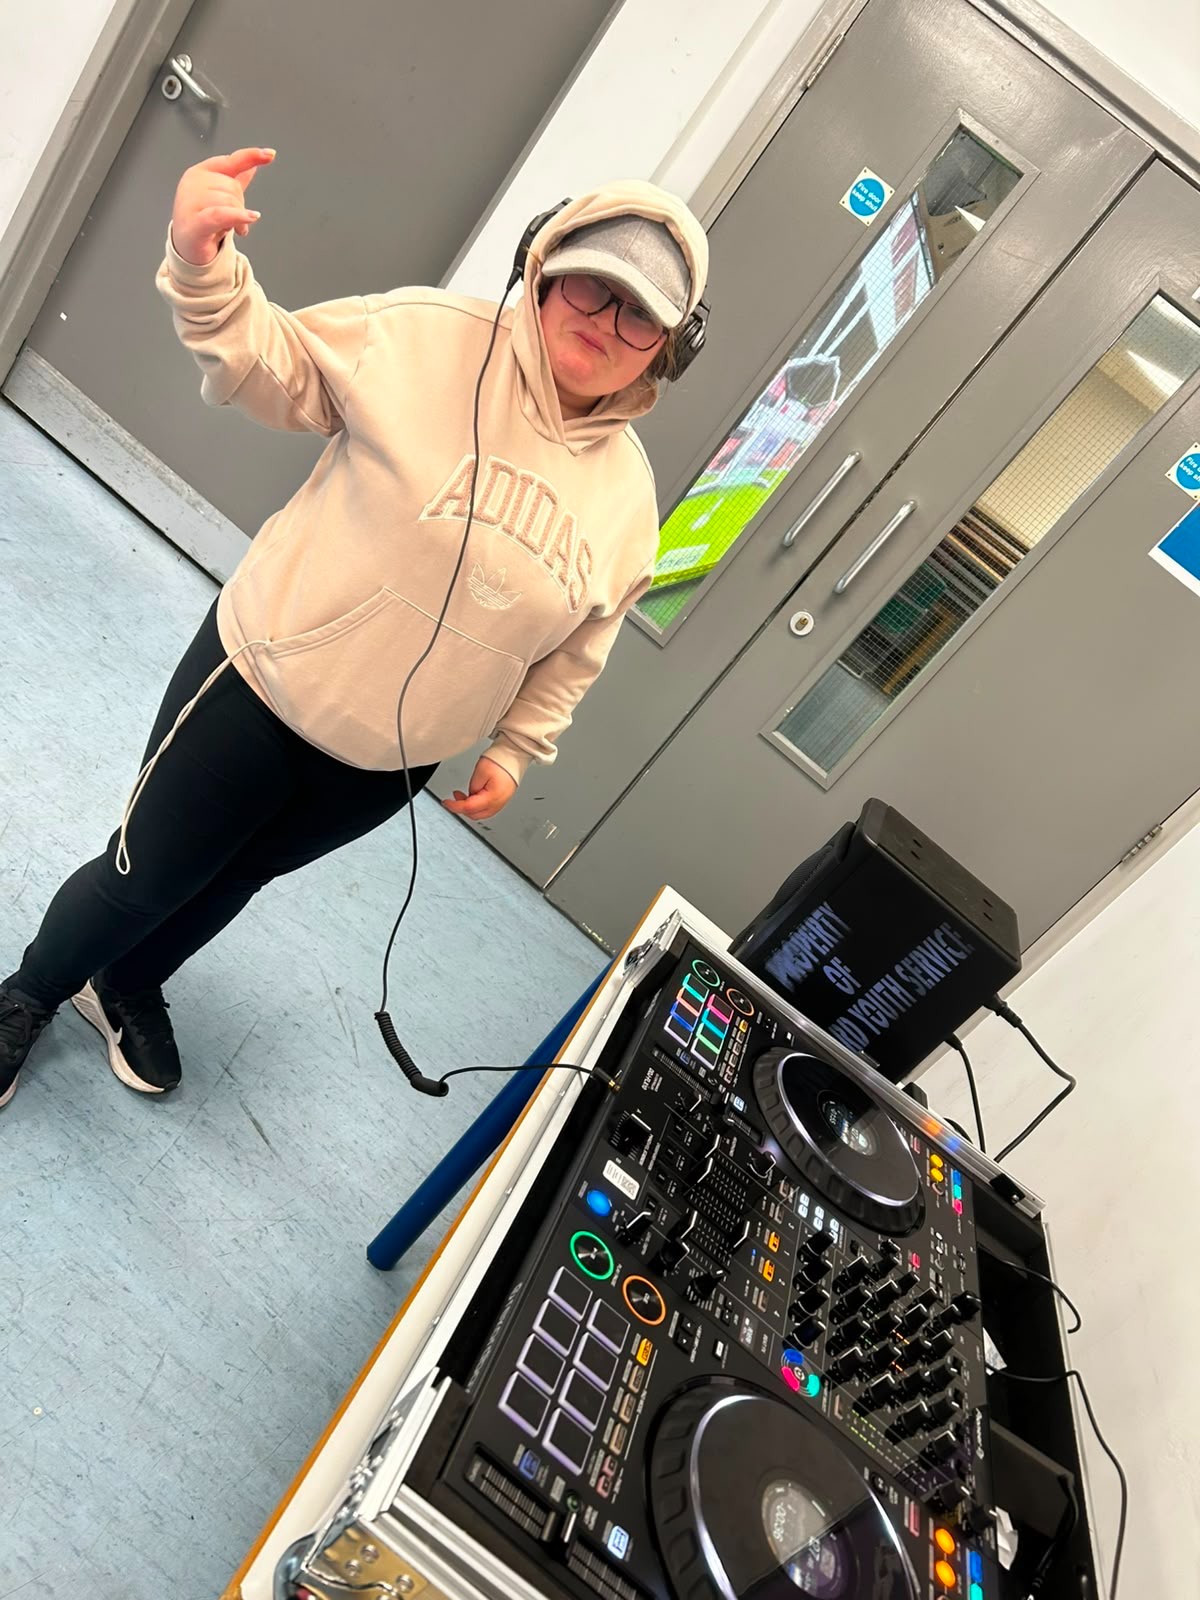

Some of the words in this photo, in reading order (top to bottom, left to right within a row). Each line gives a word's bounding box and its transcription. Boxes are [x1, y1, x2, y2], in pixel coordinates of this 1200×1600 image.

[852, 188, 866, 202] keep
[865, 199, 878, 211] shut
[857, 182, 869, 195] Fire
[868, 192, 881, 204] door
[1180, 461, 1194, 476] keep
[1186, 456, 1198, 469] Fire
[419, 455, 592, 612] ADIDAS
[765, 901, 850, 992] PROPERTY
[822, 956, 861, 995] OF
[847, 973, 917, 1035] YOUTH
[894, 921, 976, 997] SERVICE
